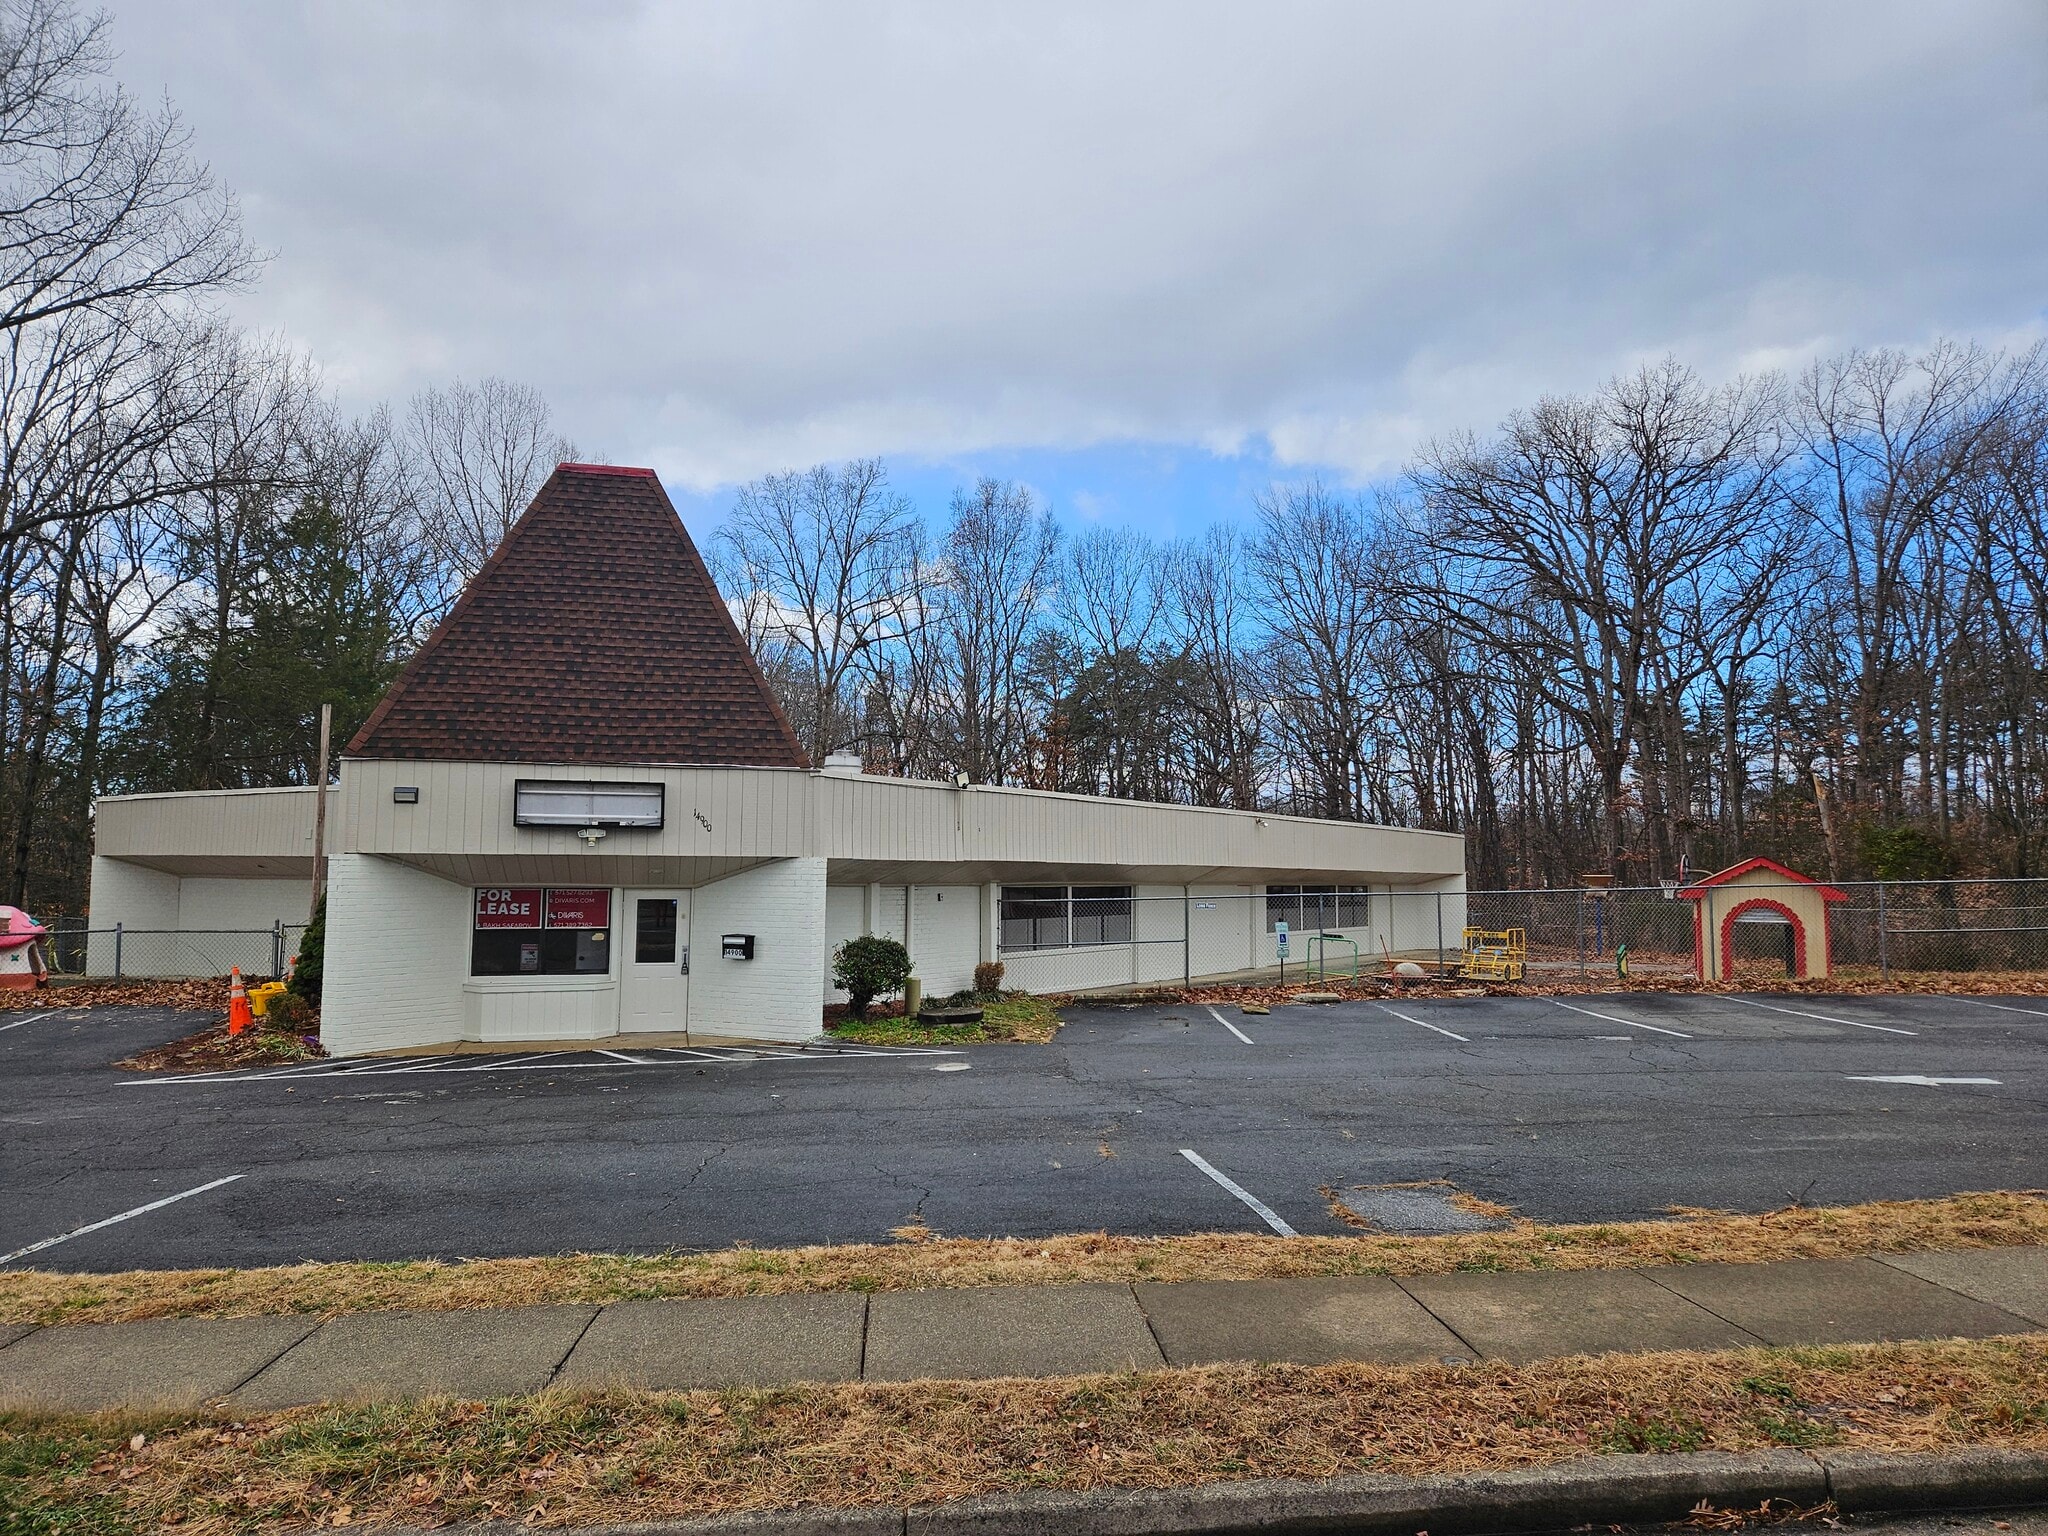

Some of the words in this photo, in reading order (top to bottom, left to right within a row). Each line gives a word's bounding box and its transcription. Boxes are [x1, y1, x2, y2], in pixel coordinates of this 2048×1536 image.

[693, 808, 712, 832] 14900
[477, 889, 512, 901] FOR
[476, 902, 530, 915] LEASE
[557, 911, 584, 919] DIVARIS
